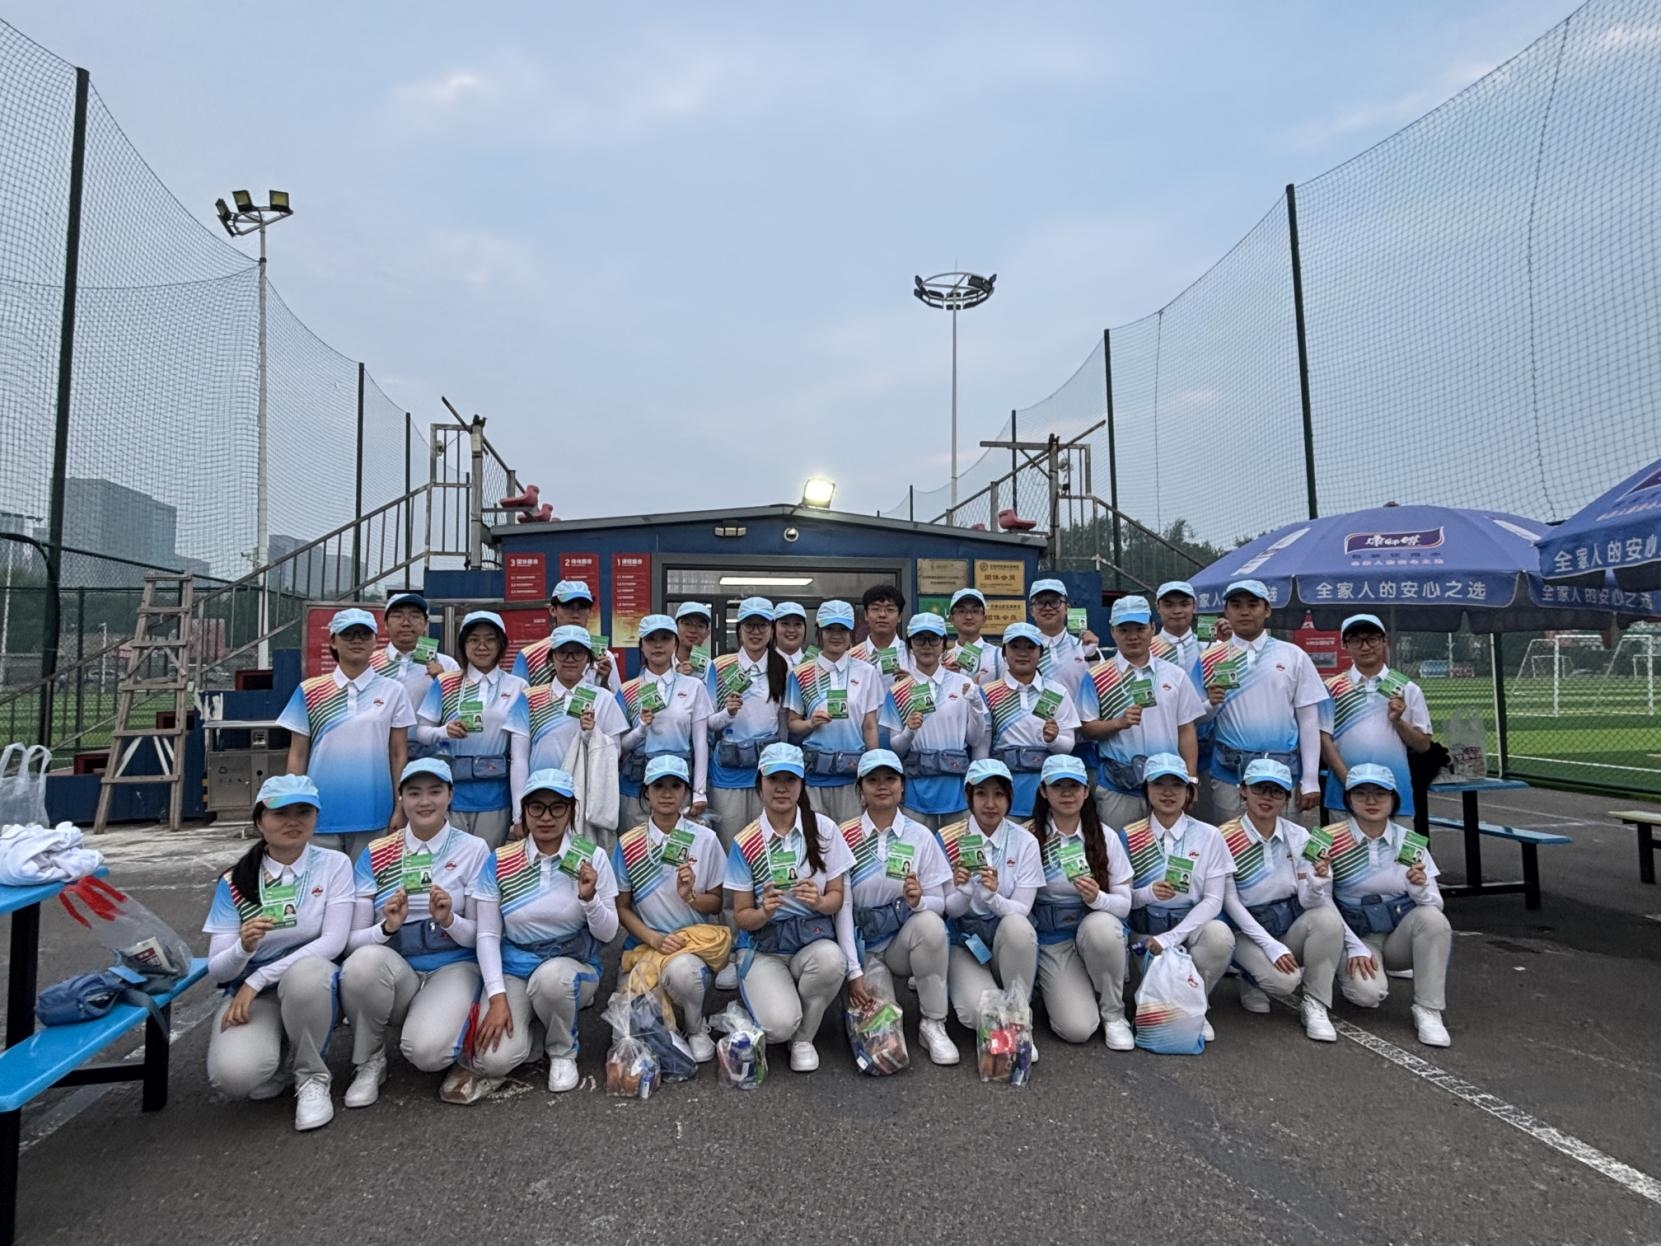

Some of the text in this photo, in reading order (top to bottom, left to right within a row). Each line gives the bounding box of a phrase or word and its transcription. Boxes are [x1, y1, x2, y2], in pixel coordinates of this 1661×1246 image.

[1554, 534, 1661, 572] 全家人的安心
[1316, 581, 1487, 600] 全家人的安心之选
